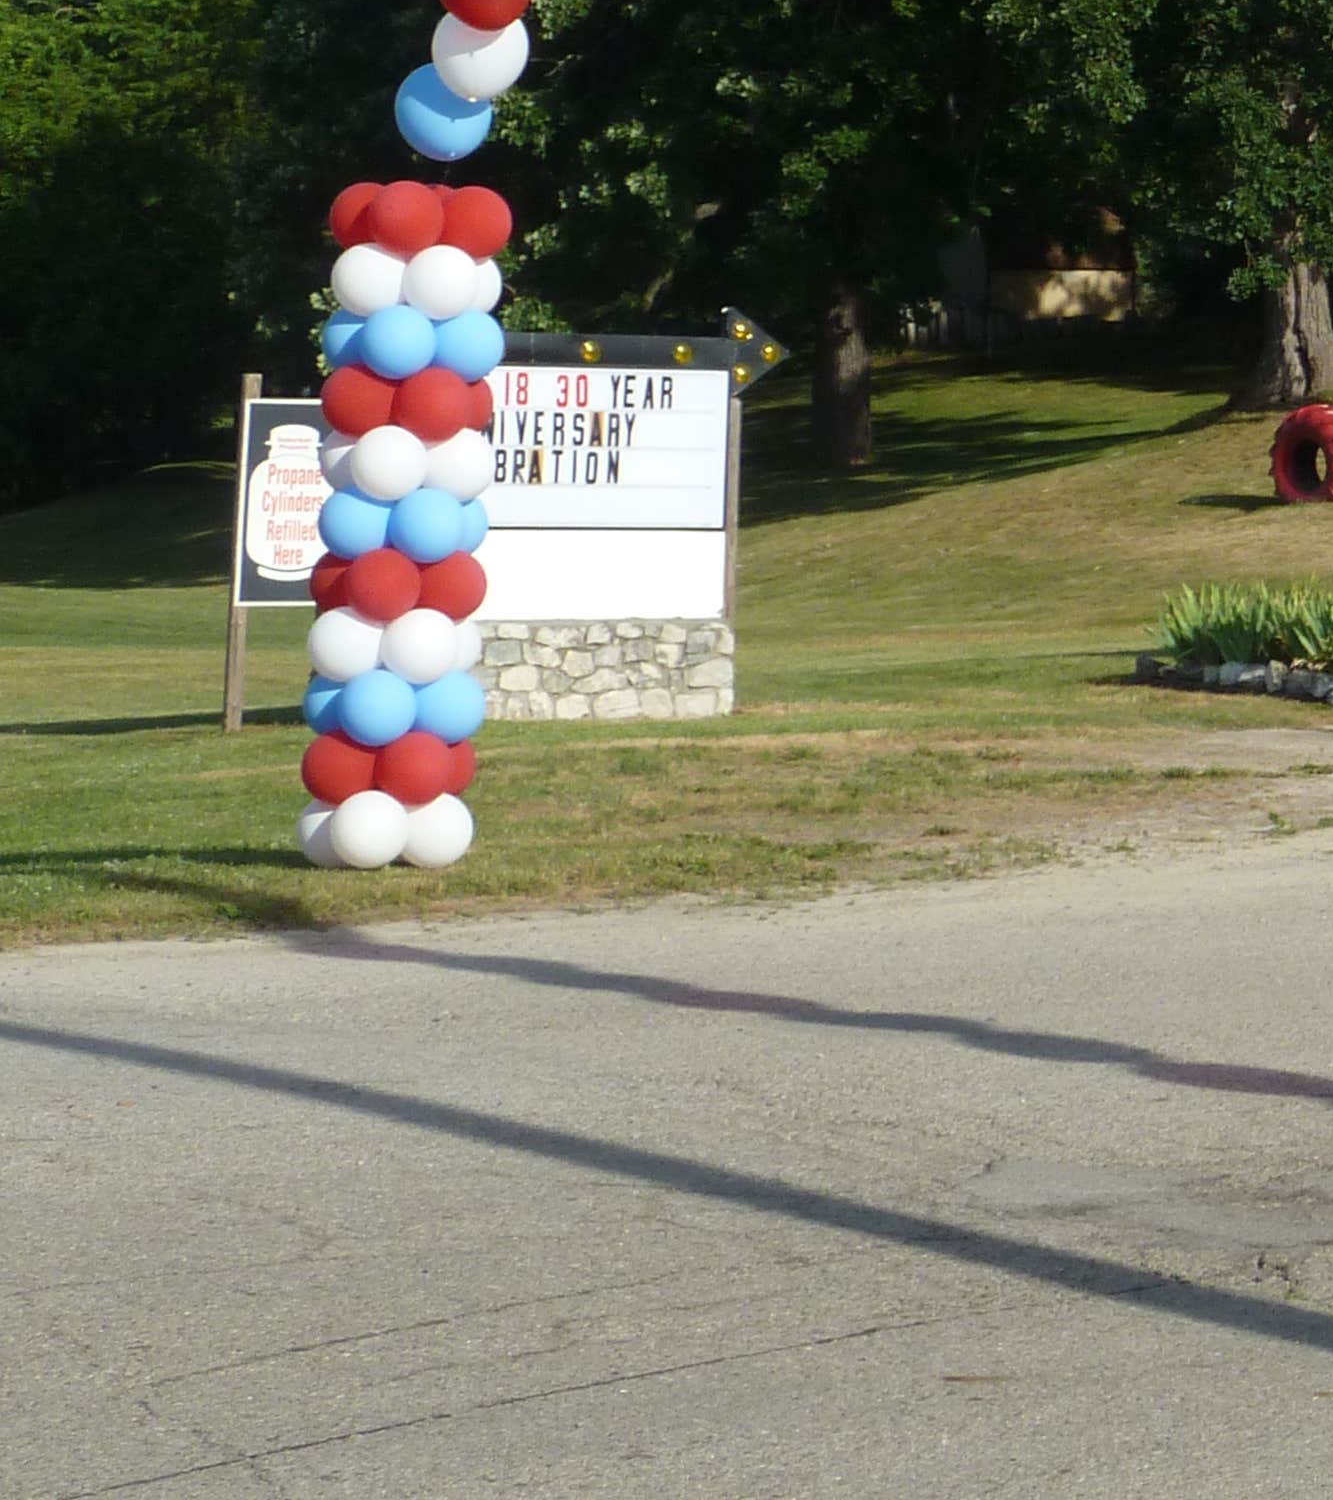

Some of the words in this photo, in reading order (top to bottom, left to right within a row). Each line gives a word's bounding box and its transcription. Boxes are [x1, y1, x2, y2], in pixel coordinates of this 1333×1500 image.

[505, 372, 530, 407] 18
[555, 374, 589, 408] 30
[611, 374, 674, 410] YEAR
[267, 463, 322, 491] Propane
[494, 449, 620, 485] BRATION
[261, 491, 324, 517] Cylinders
[265, 519, 318, 541] Refilled
[272, 544, 304, 566] Here
